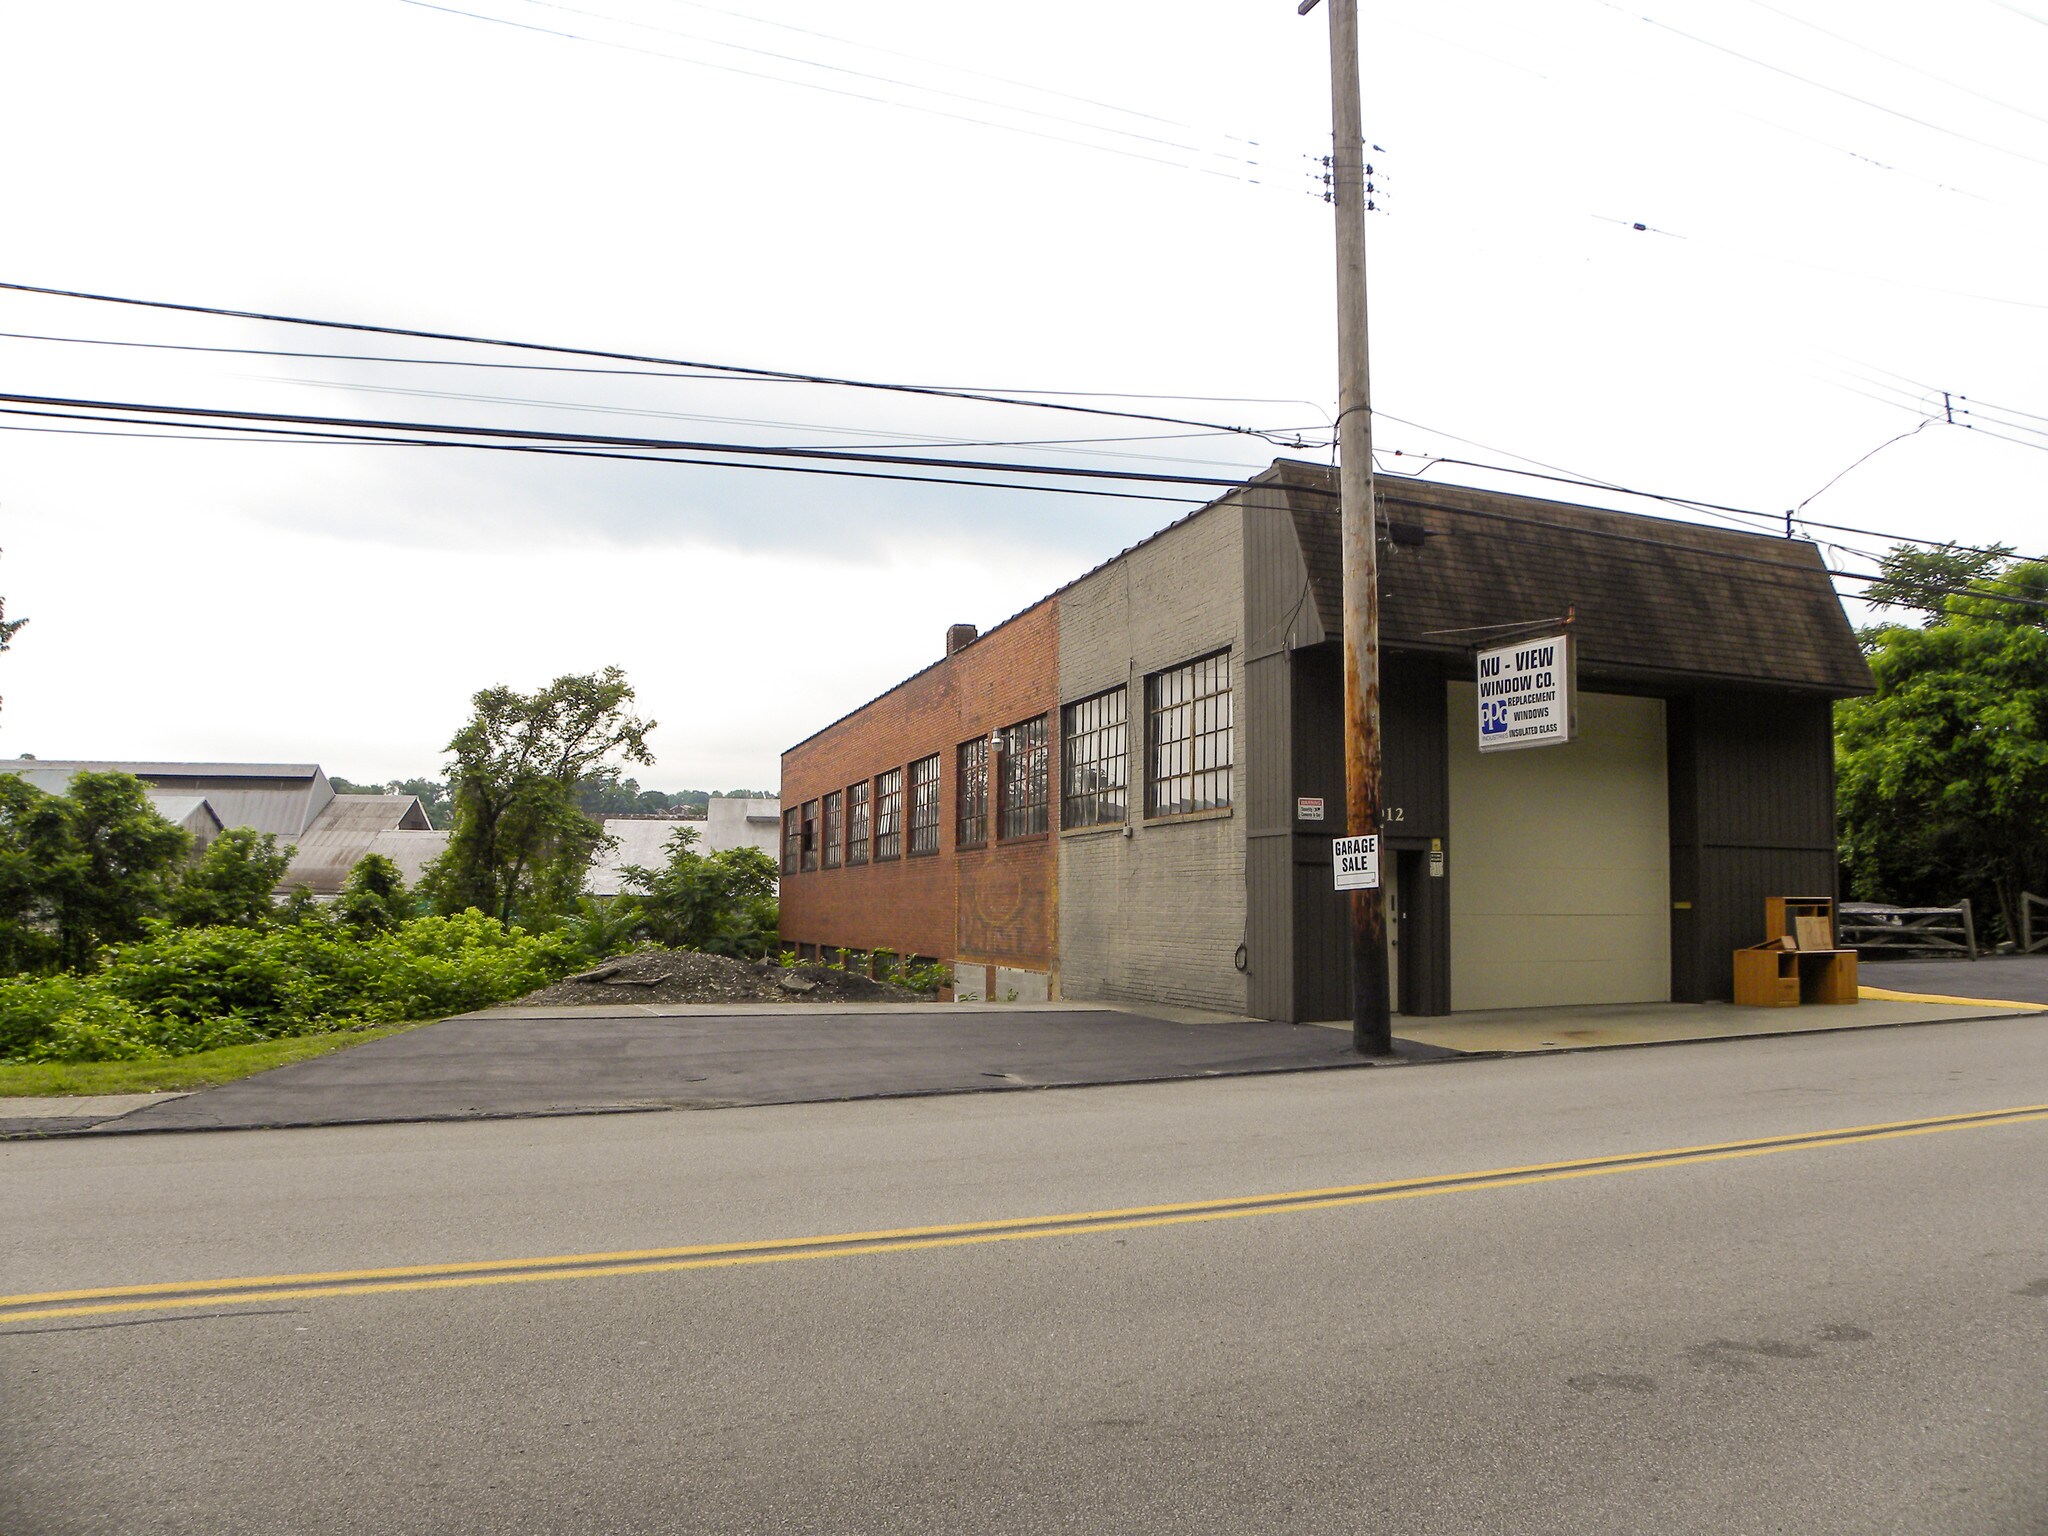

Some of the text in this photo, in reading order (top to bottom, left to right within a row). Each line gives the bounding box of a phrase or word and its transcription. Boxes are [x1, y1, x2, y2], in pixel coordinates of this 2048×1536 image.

[1480, 656, 1500, 678] NU
[1516, 646, 1553, 671] VIEW
[1480, 671, 1555, 697] WINDOW CO.
[1508, 691, 1555, 706] REPLACEMENT
[1514, 707, 1549, 721] WINDOWS
[1509, 723, 1558, 738] INSULATED GLASS
[1335, 838, 1375, 856] GARAGE
[1342, 856, 1368, 873] SALE
